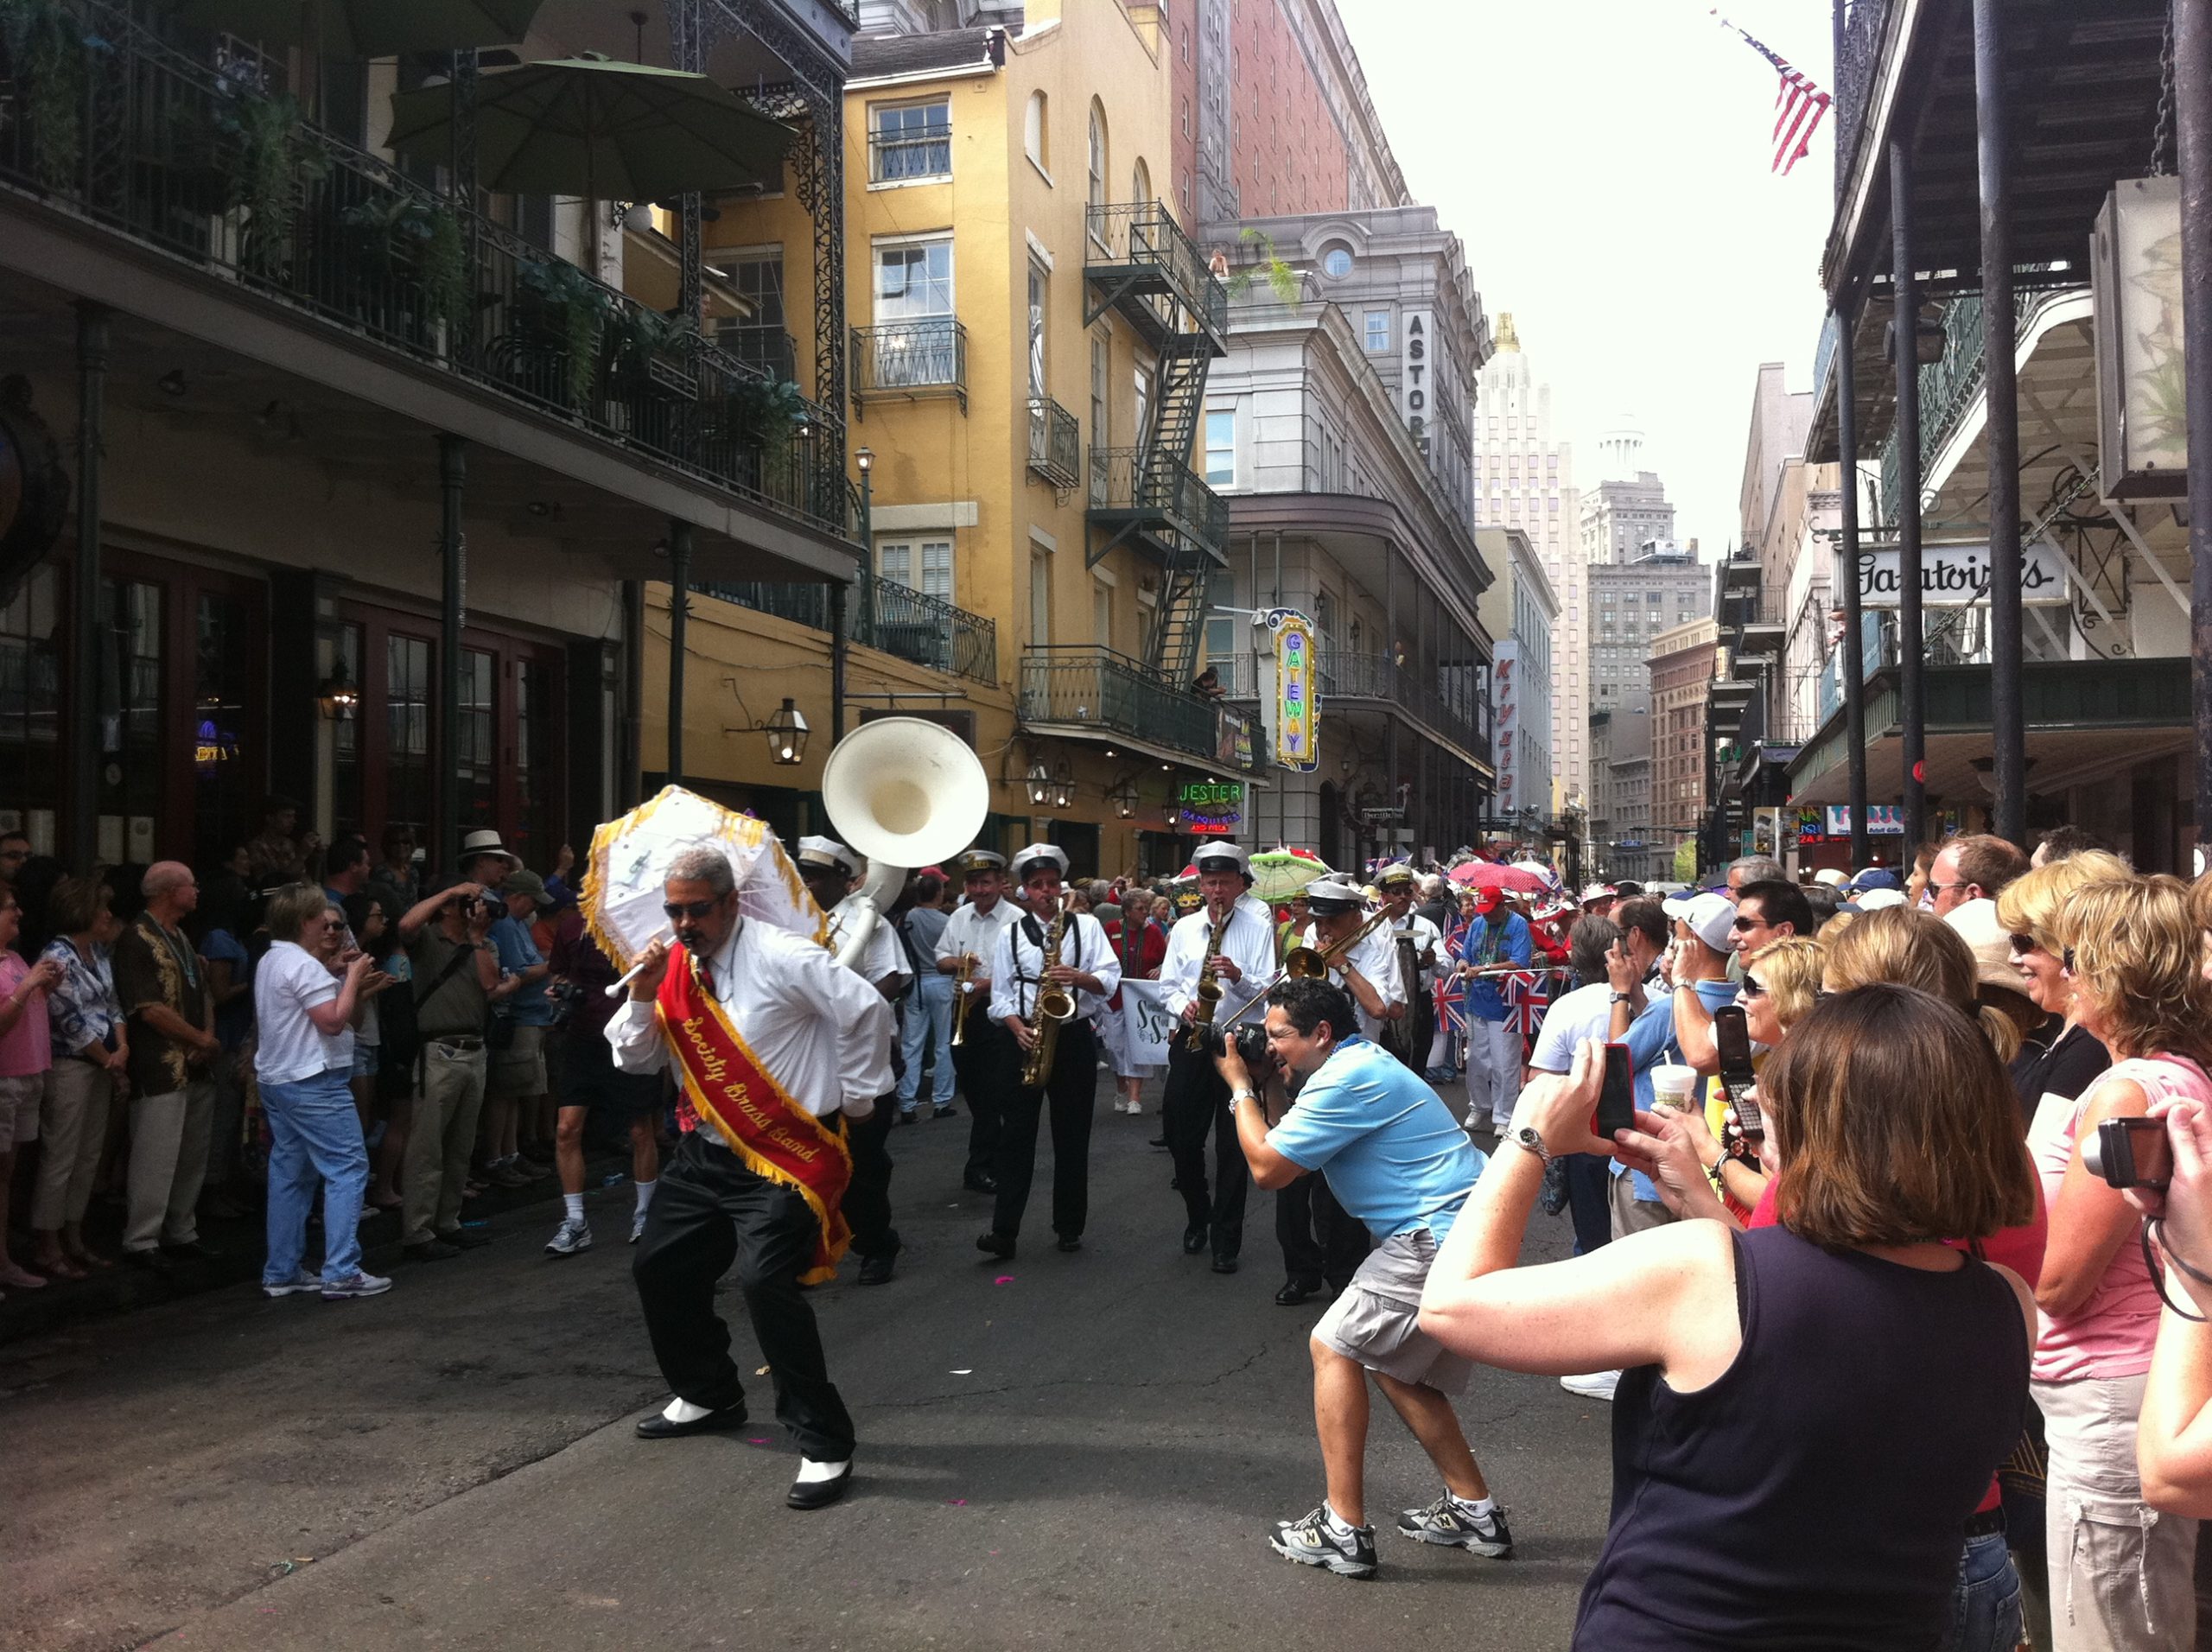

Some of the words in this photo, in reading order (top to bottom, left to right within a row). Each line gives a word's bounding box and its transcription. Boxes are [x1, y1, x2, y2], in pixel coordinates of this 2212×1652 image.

[1408, 315, 1425, 435] ASTOR
[1285, 633, 1305, 752] GATEWAY
[1496, 658, 1515, 814] Krystal
[1179, 785, 1241, 801] JESTER
[682, 1016, 728, 1083] Society
[723, 1082, 774, 1131] Brass
[767, 1126, 821, 1164] Band
[1306, 1532, 1316, 1543] N
